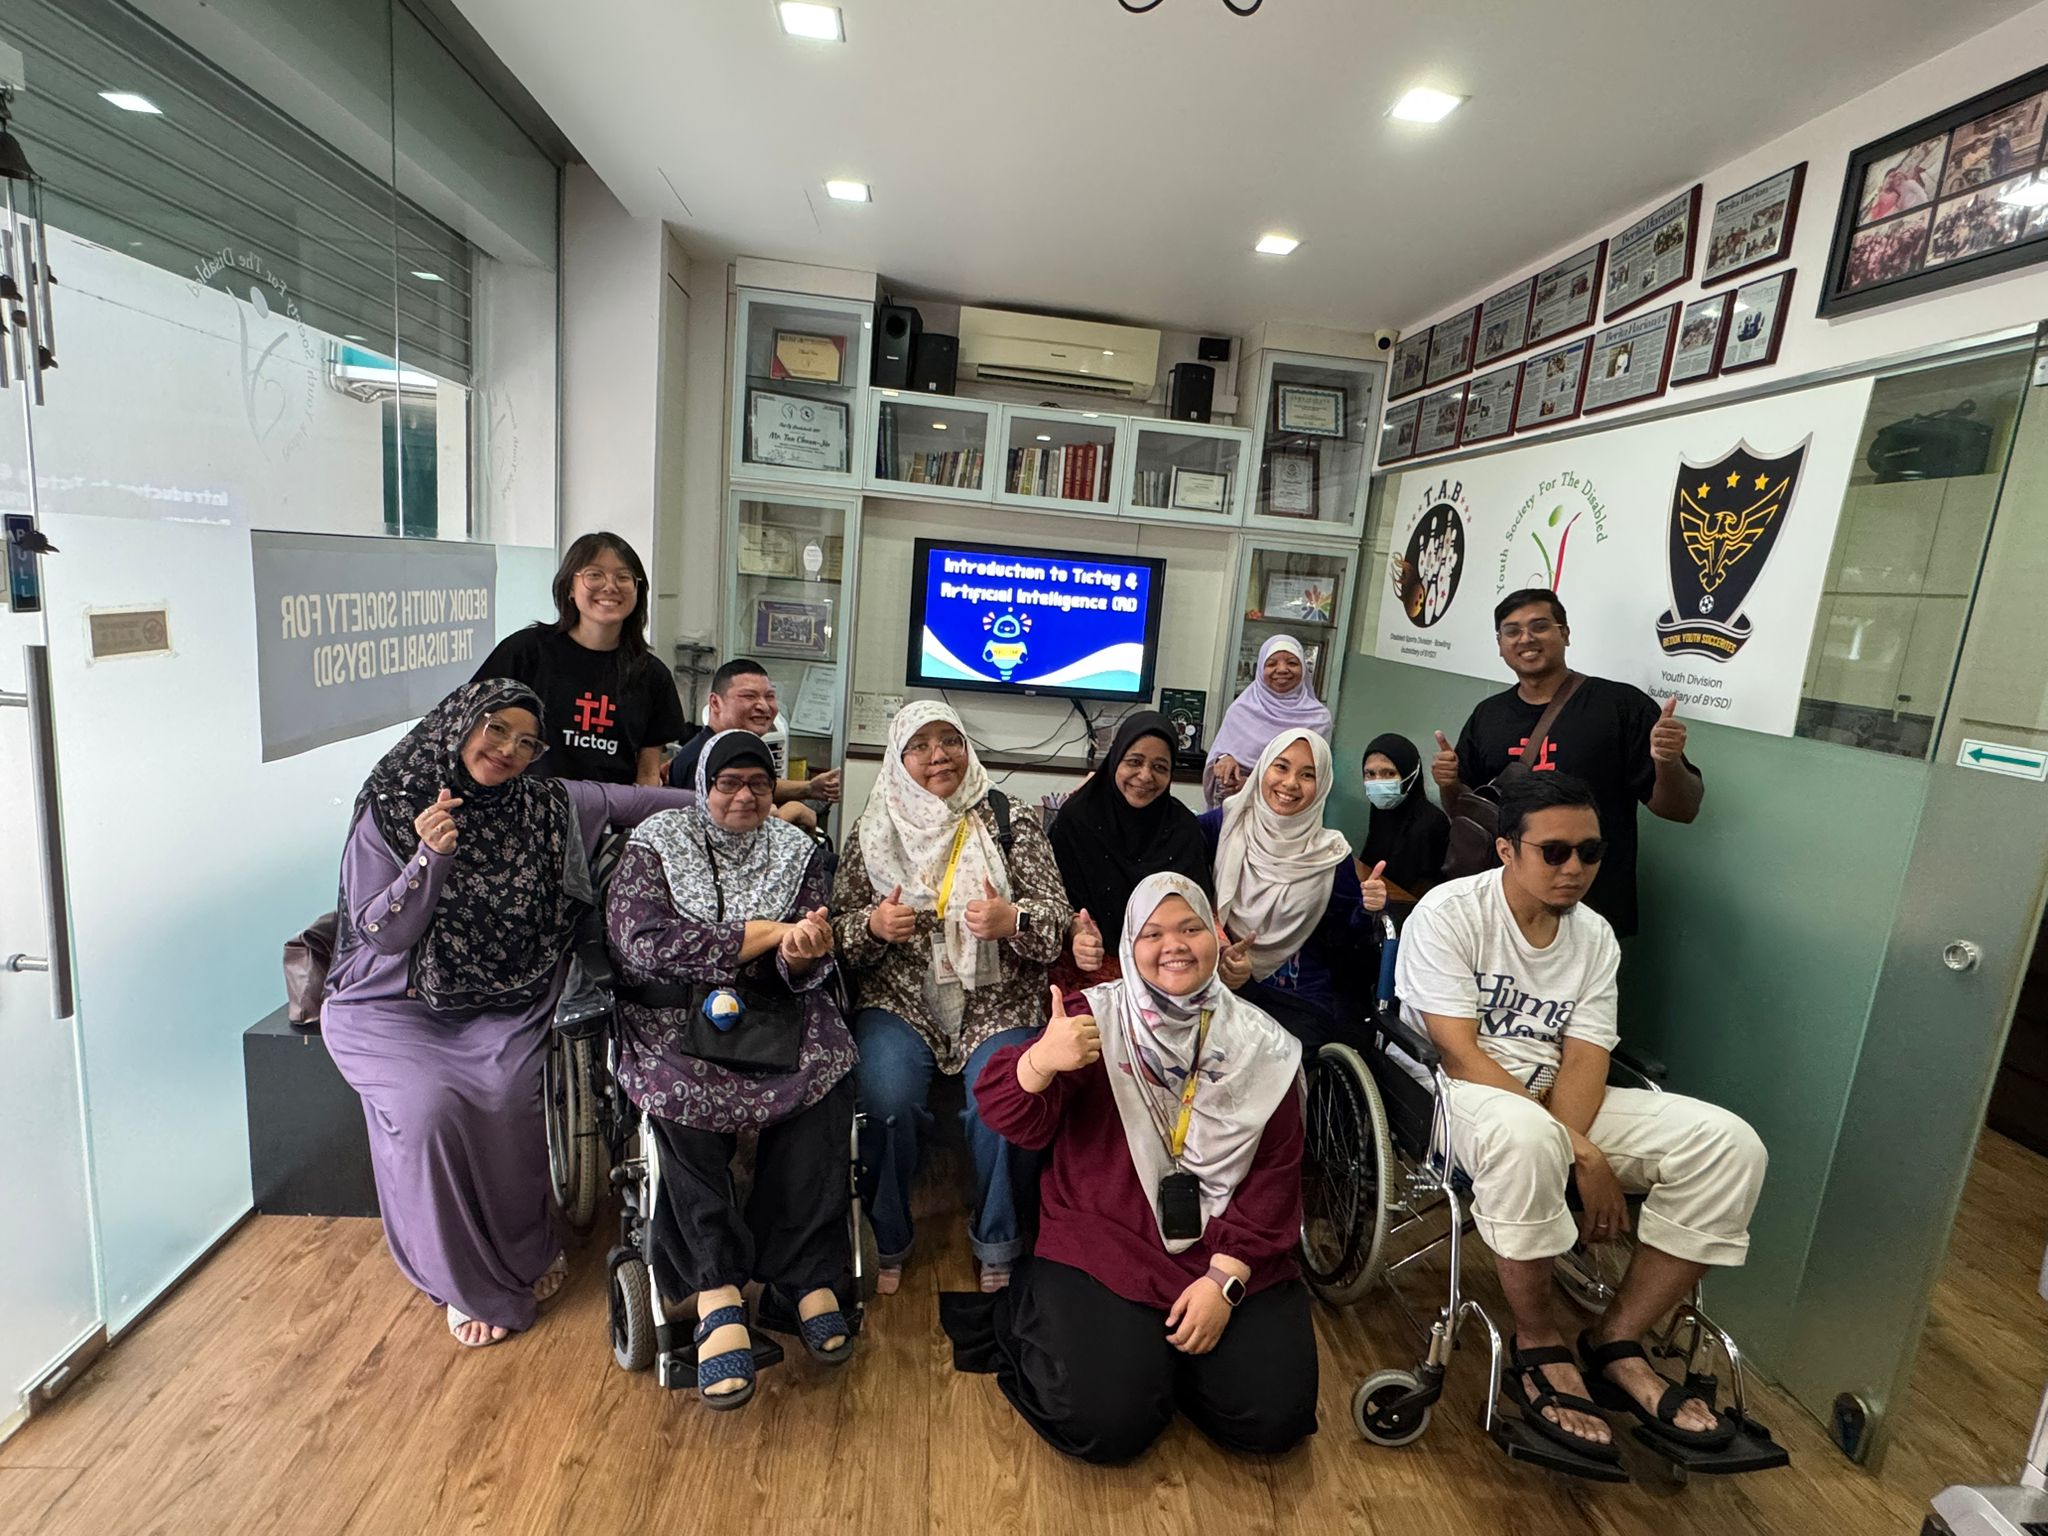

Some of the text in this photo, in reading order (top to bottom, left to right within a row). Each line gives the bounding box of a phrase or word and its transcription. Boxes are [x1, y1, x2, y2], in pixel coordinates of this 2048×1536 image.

[1496, 471, 1608, 595] Youth Society For The Disabled
[944, 557, 1138, 591] Introduction to Tictag &
[940, 582, 1138, 612] Artificial Intelligence (AI)
[1661, 670, 1722, 689] Youth Division
[1692, 693, 1701, 703] of
[1702, 695, 1732, 710] BYSD)
[563, 729, 618, 755] Tictag
